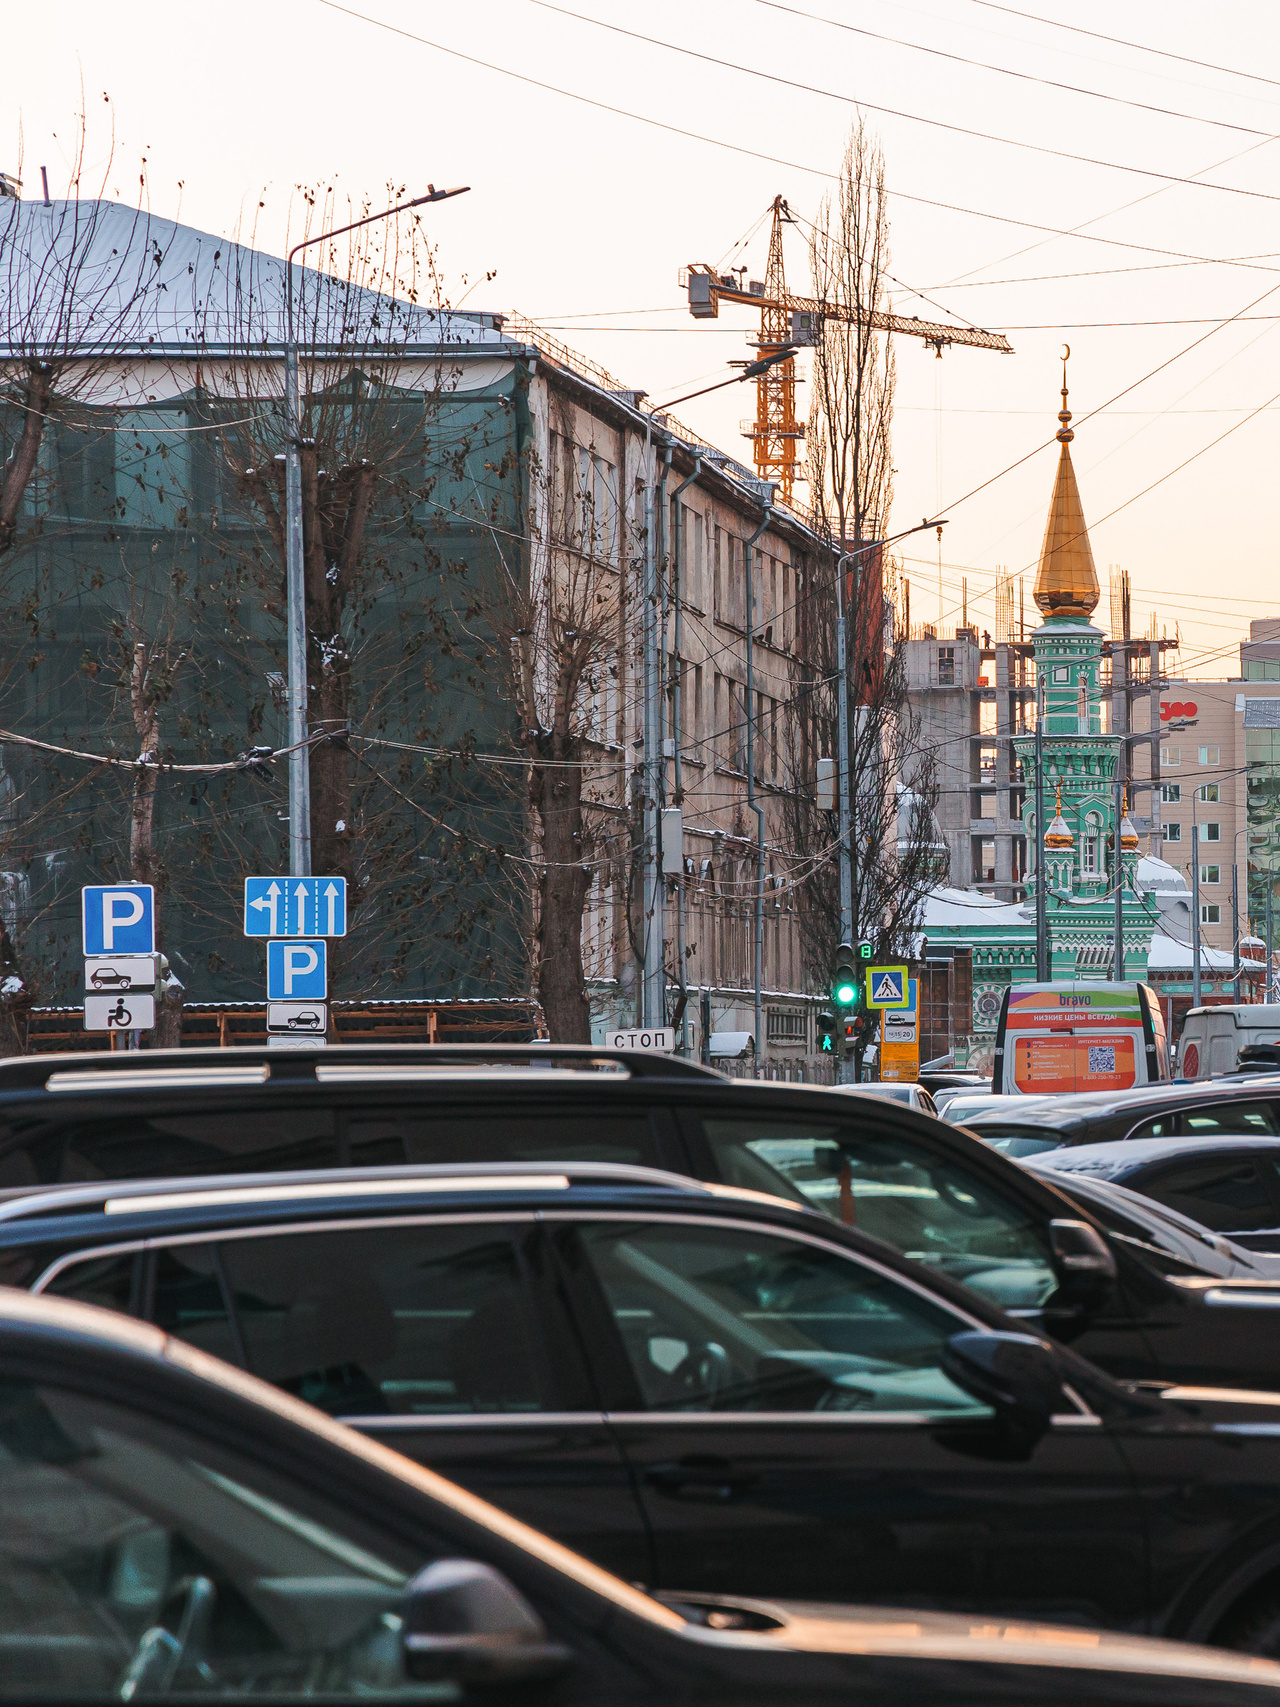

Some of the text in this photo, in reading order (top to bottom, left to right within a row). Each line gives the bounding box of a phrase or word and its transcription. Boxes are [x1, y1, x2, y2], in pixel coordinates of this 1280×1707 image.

[102, 891, 145, 950] P
[283, 945, 319, 995] P
[1059, 993, 1091, 1006] bravo
[1087, 1013, 1118, 1021] ВСЕГДА!
[614, 1032, 665, 1049] СТОП
